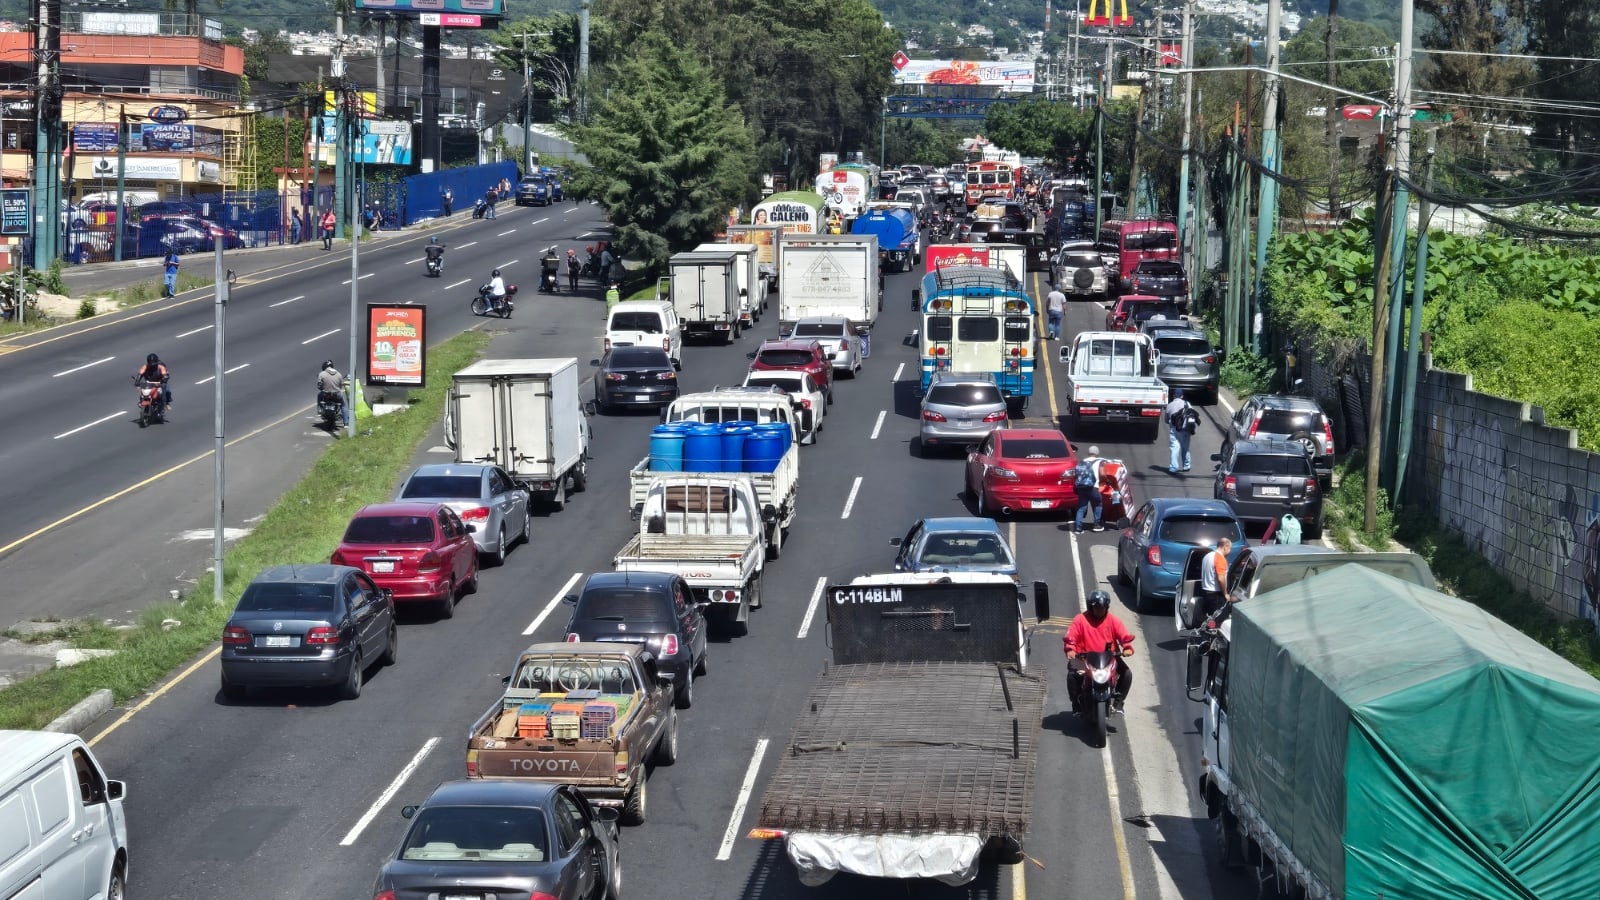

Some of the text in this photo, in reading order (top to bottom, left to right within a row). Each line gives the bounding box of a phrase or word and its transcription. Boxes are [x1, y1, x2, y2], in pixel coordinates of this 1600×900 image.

[770, 212, 809, 222] GALENO
[797, 224, 812, 232] 1702
[835, 588, 902, 604] C-114BLM
[510, 759, 581, 772] TOYOTA
